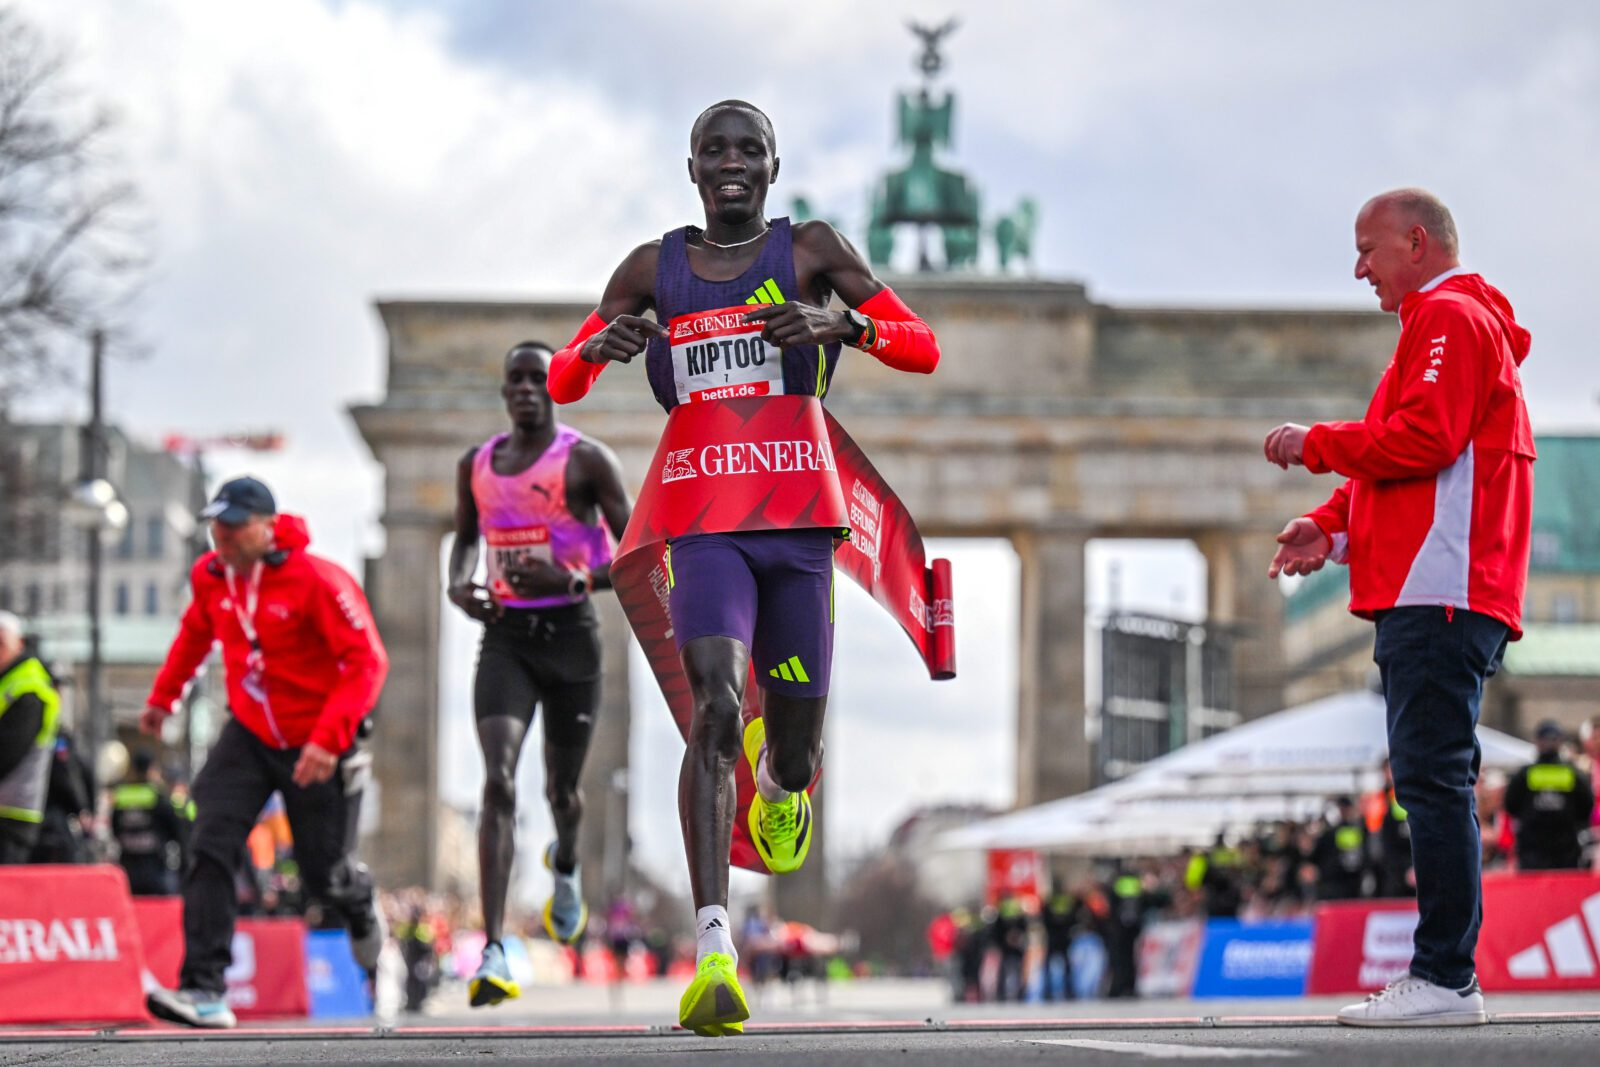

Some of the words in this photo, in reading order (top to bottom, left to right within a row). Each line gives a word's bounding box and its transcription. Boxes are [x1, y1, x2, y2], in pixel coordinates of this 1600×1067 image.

[693, 312, 767, 333] GENER
[685, 336, 766, 377] KIPTOO
[1423, 334, 1446, 383] TEAM
[723, 373, 729, 383] 7
[701, 385, 756, 401] bett1.de
